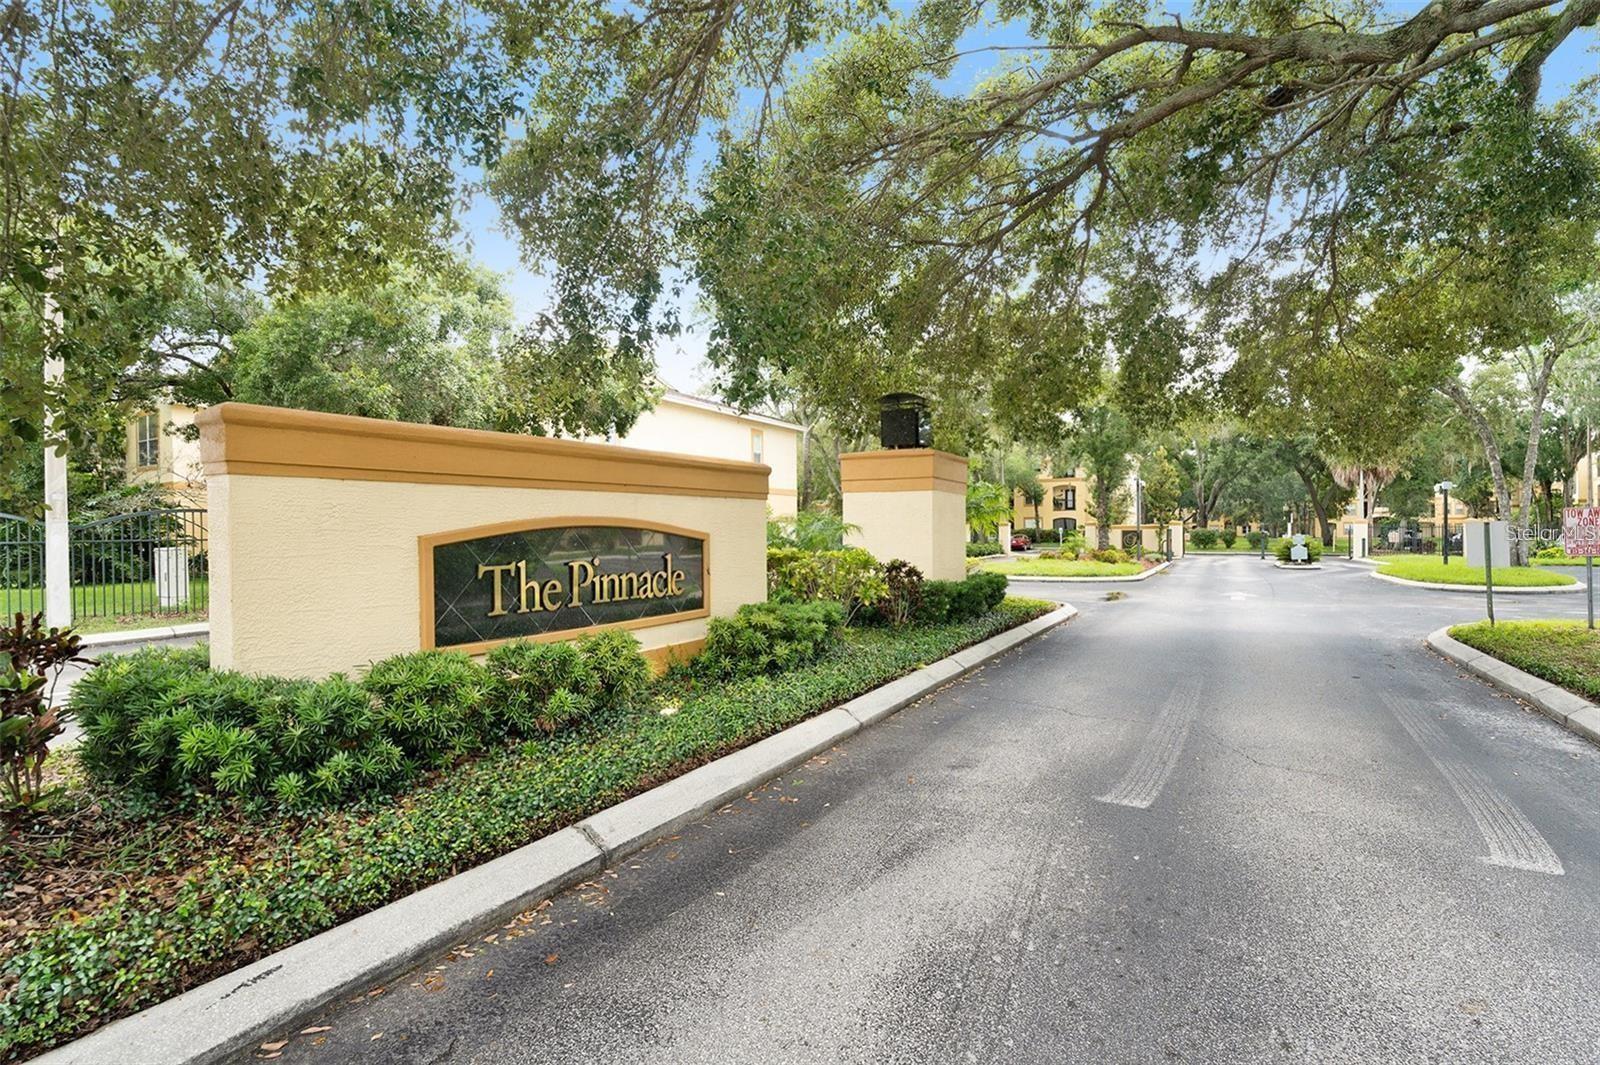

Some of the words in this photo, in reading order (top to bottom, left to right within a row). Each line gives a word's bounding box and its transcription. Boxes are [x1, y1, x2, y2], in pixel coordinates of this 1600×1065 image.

[1566, 509, 1583, 518] TOW
[1577, 517, 1599, 526] ZONE
[477, 560, 563, 617] The
[566, 553, 686, 609] Pinnacle
